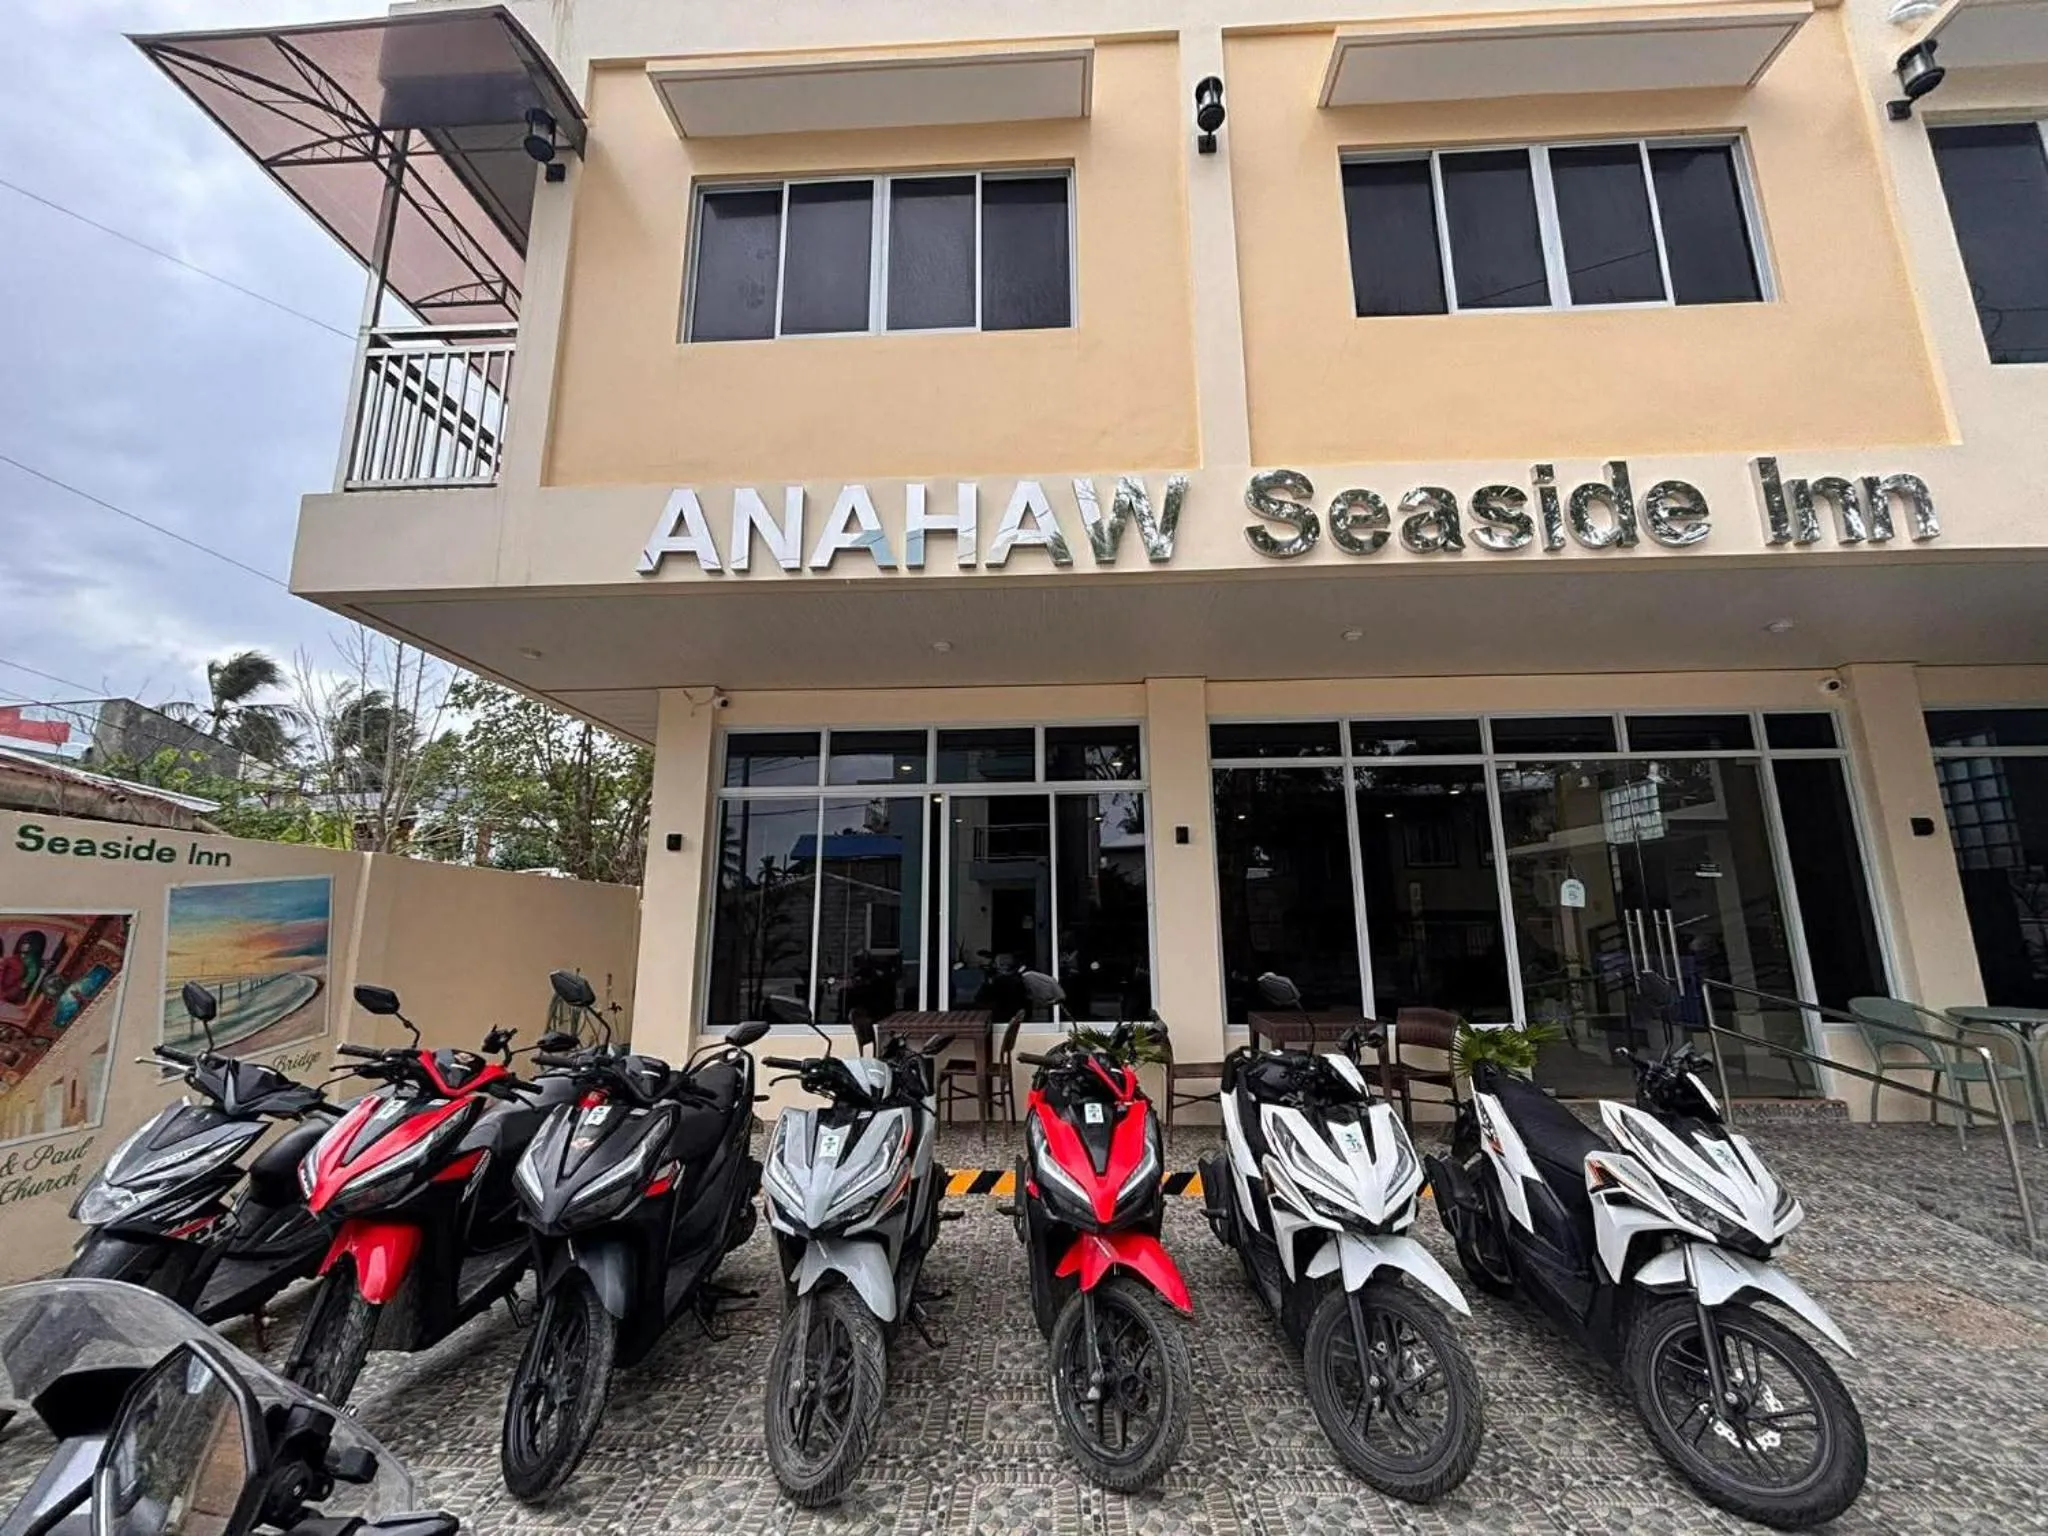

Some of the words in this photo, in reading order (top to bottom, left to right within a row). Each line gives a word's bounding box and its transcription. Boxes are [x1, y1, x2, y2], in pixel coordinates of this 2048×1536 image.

[636, 474, 1190, 575] ANAHAW
[1244, 461, 1712, 559] Seaside
[1749, 456, 1940, 546] Inn
[15, 823, 177, 864] Seaside
[187, 842, 232, 867] Inn
[272, 1050, 322, 1073] Bridge
[23, 1136, 95, 1172] Paul
[0, 1164, 81, 1206] Church
